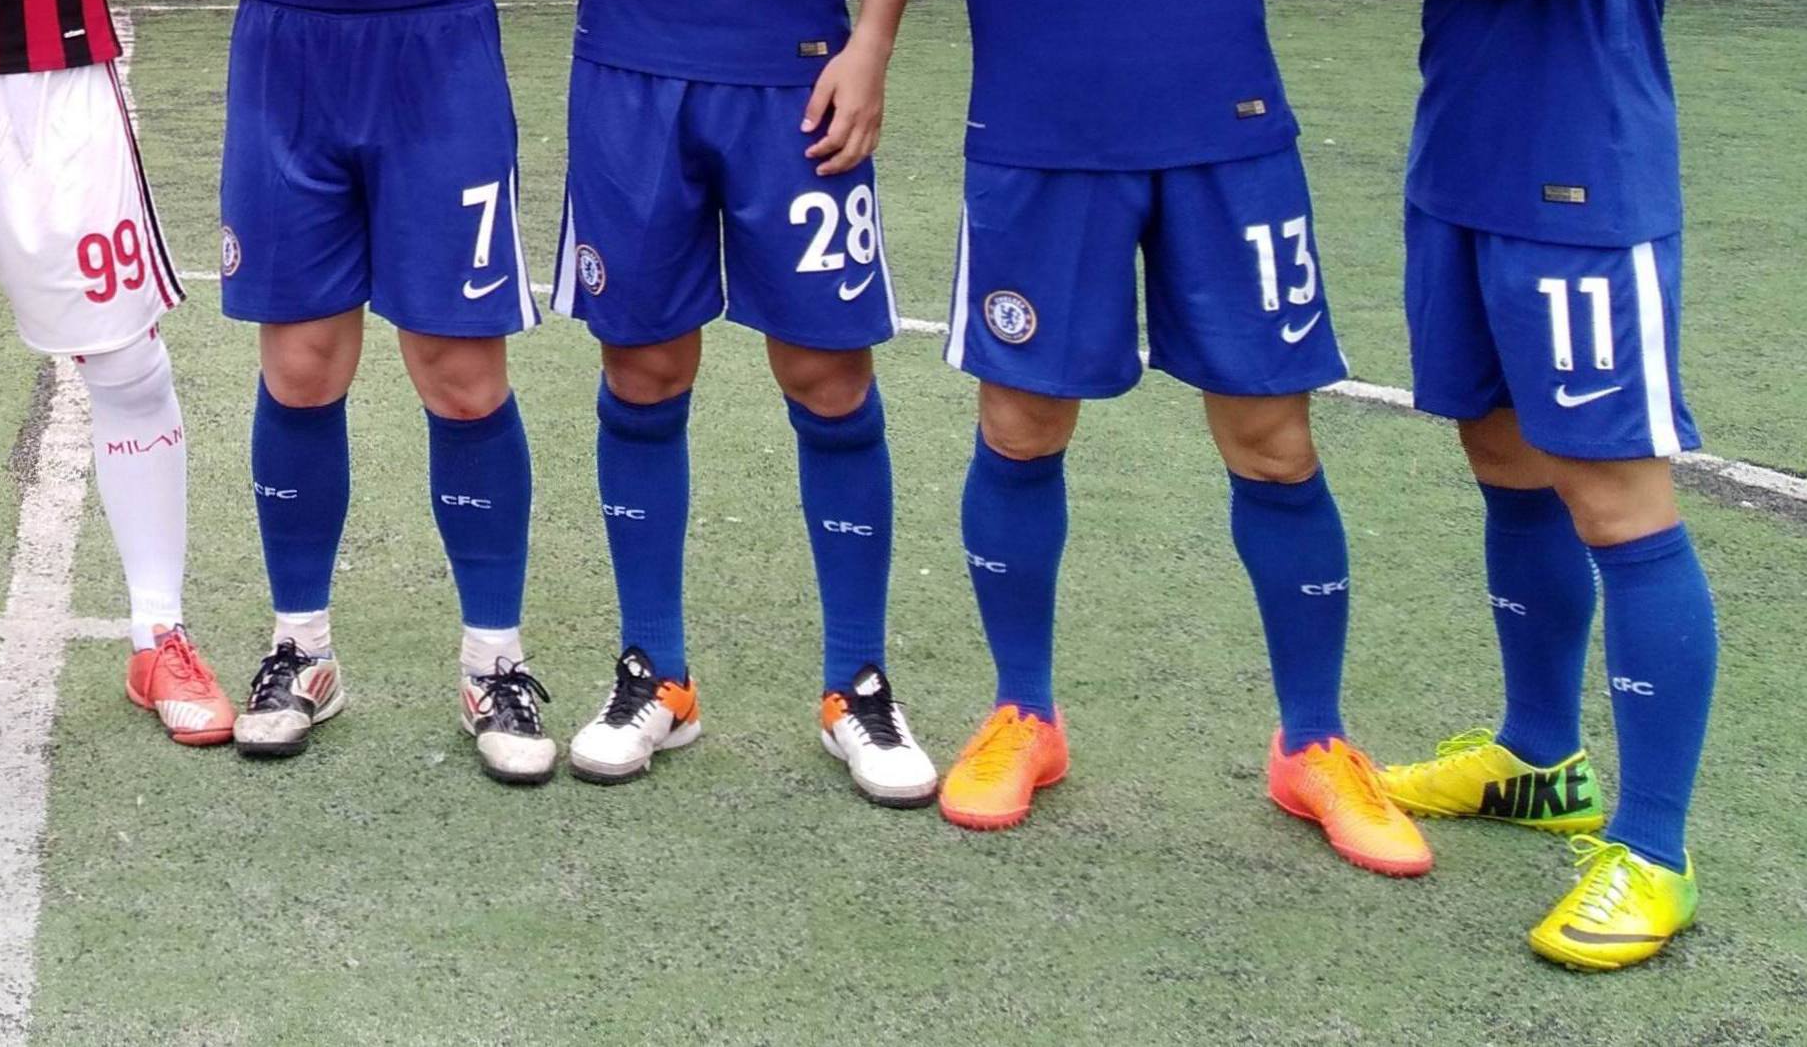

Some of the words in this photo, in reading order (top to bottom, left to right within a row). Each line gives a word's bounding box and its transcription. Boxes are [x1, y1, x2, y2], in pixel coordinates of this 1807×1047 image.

[462, 181, 500, 268] 7
[789, 184, 876, 273] 28
[76, 219, 146, 303] 99
[1245, 215, 1316, 312] 13
[1537, 277, 1614, 371] 11
[106, 426, 182, 455] MILAN
[254, 481, 298, 499] CFC
[441, 493, 492, 509] CFC
[602, 503, 646, 520] CFC
[821, 519, 873, 536] CFC
[1301, 577, 1349, 595] CFC
[1488, 593, 1527, 615] CFC
[1612, 676, 1655, 697] CFC
[1479, 755, 1591, 818] NIKE
